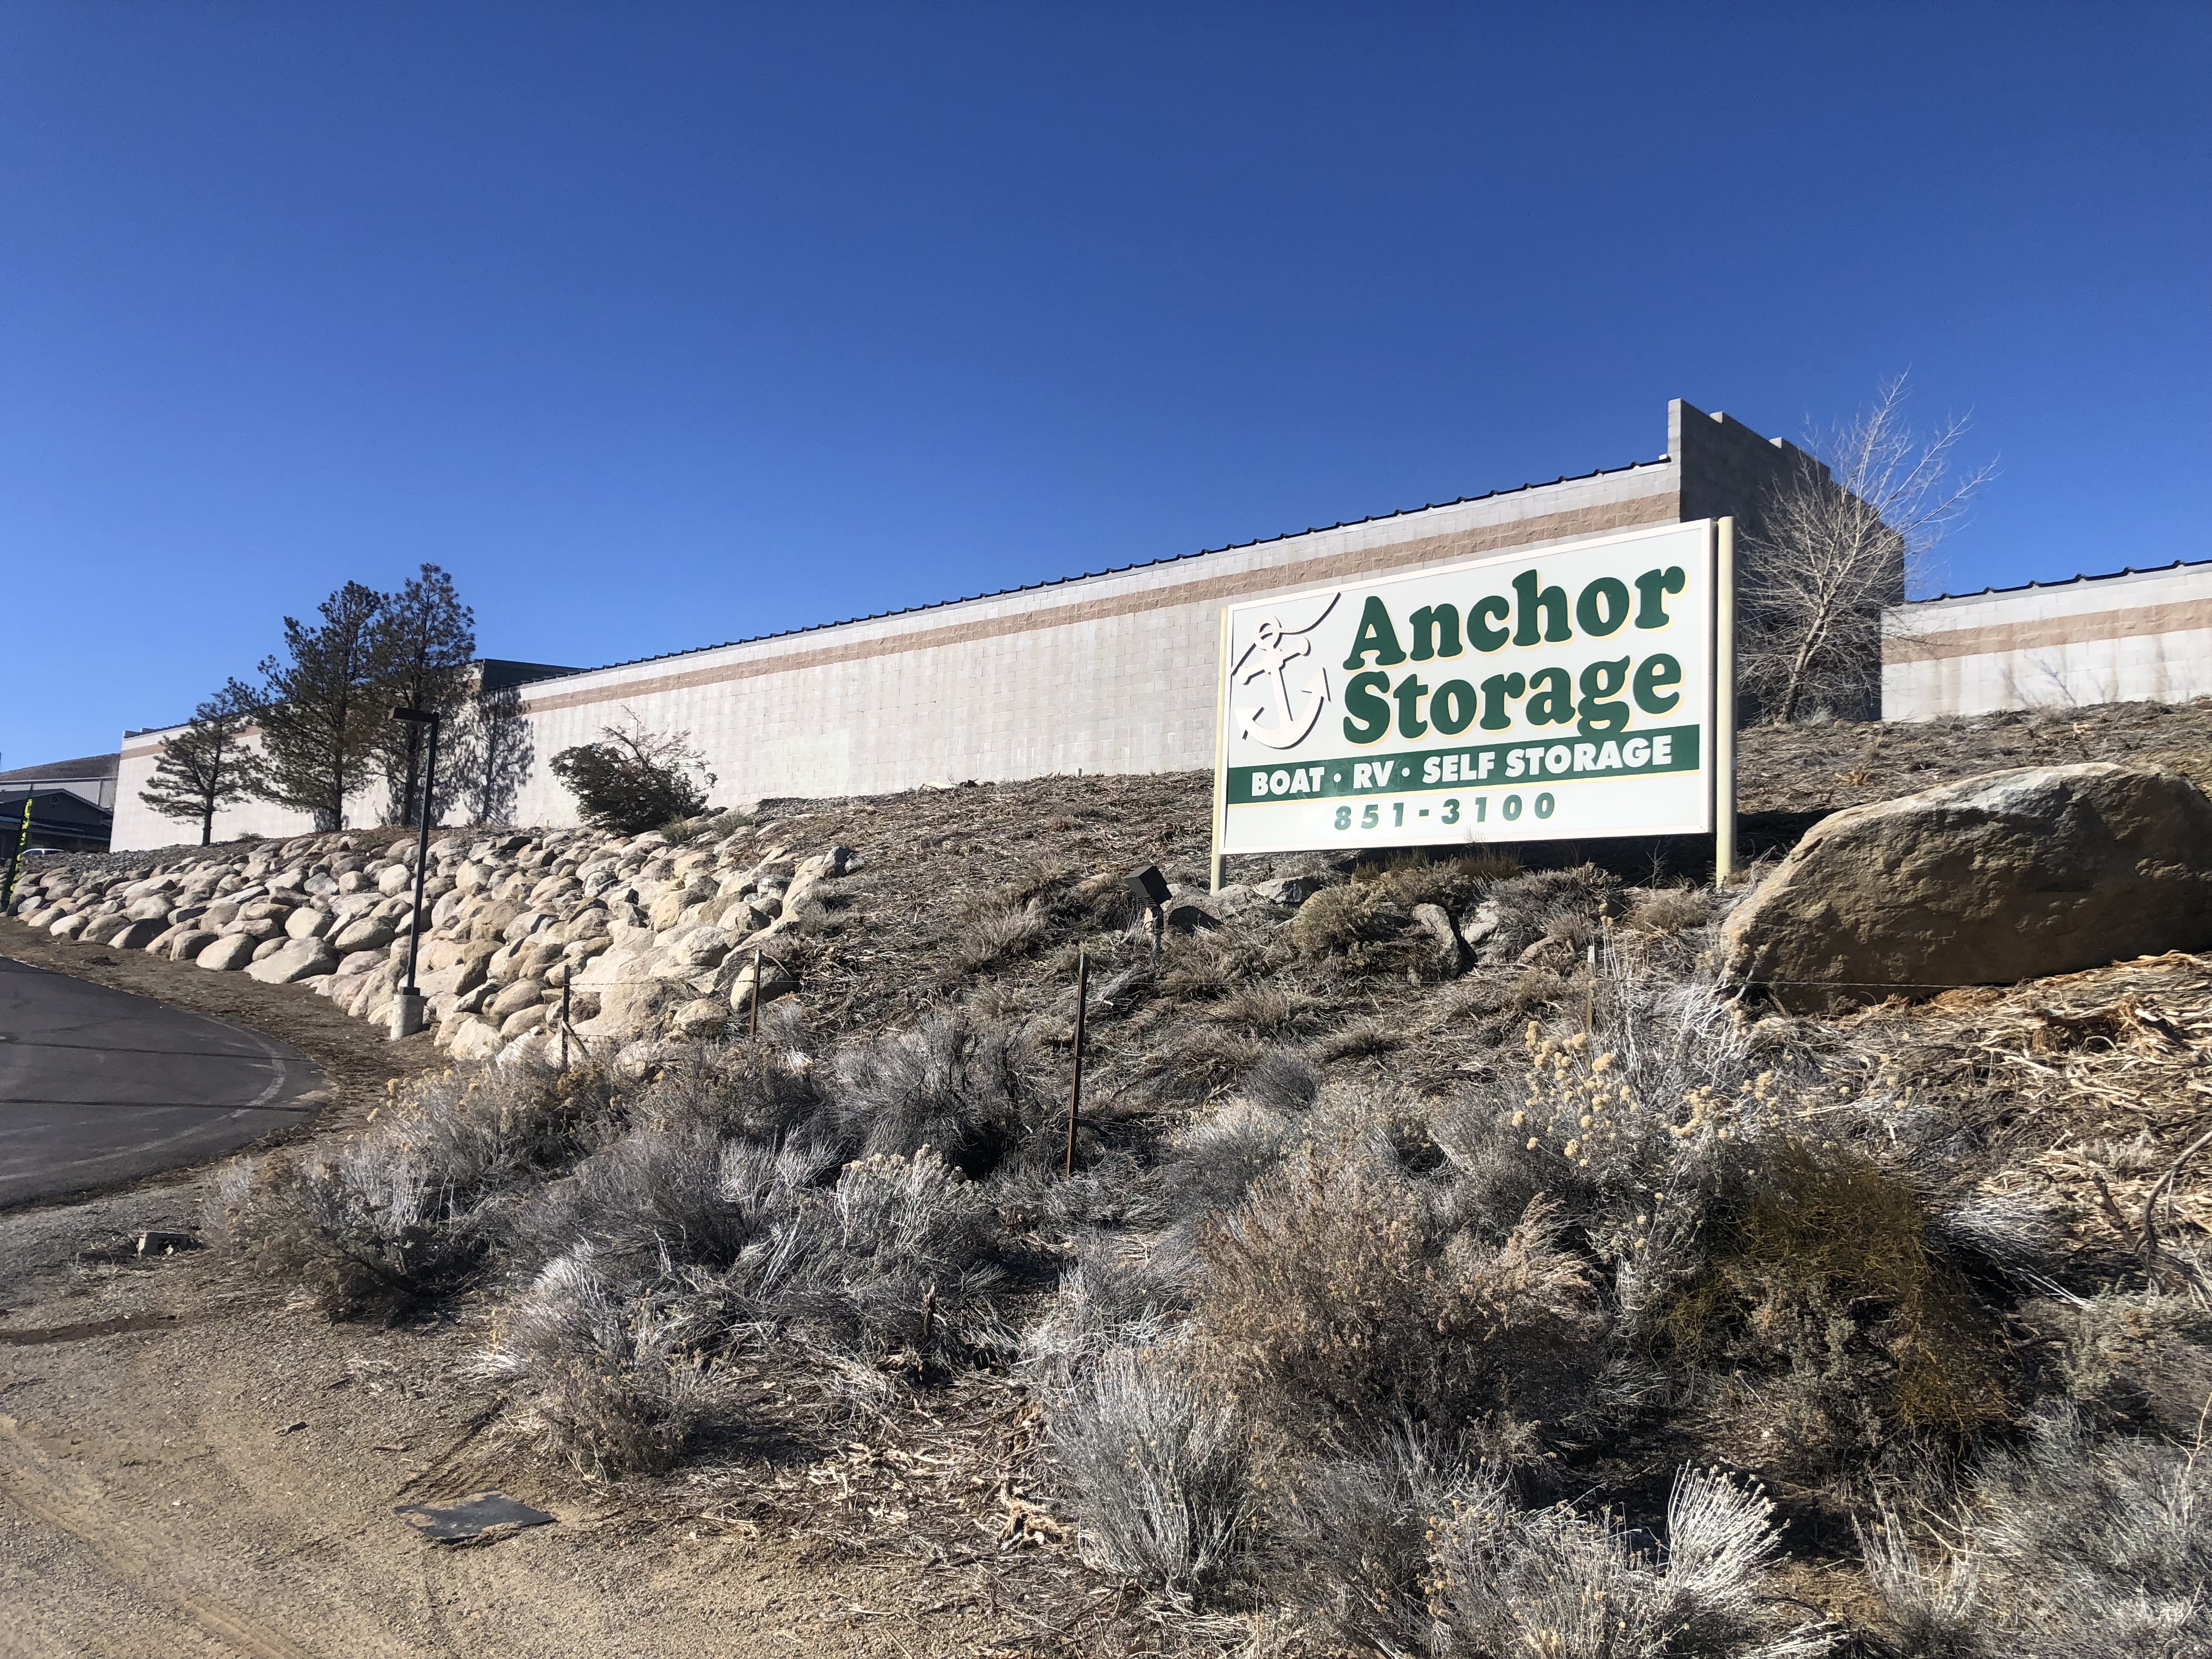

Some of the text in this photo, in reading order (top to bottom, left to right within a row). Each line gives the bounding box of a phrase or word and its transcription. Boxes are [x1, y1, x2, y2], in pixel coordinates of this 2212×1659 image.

[1342, 566, 1686, 670] Anchor
[1342, 653, 1682, 745] Storage
[1251, 735, 1673, 797] BOAT RV SELF STORAGE
[1334, 792, 1556, 831] 851-3100
